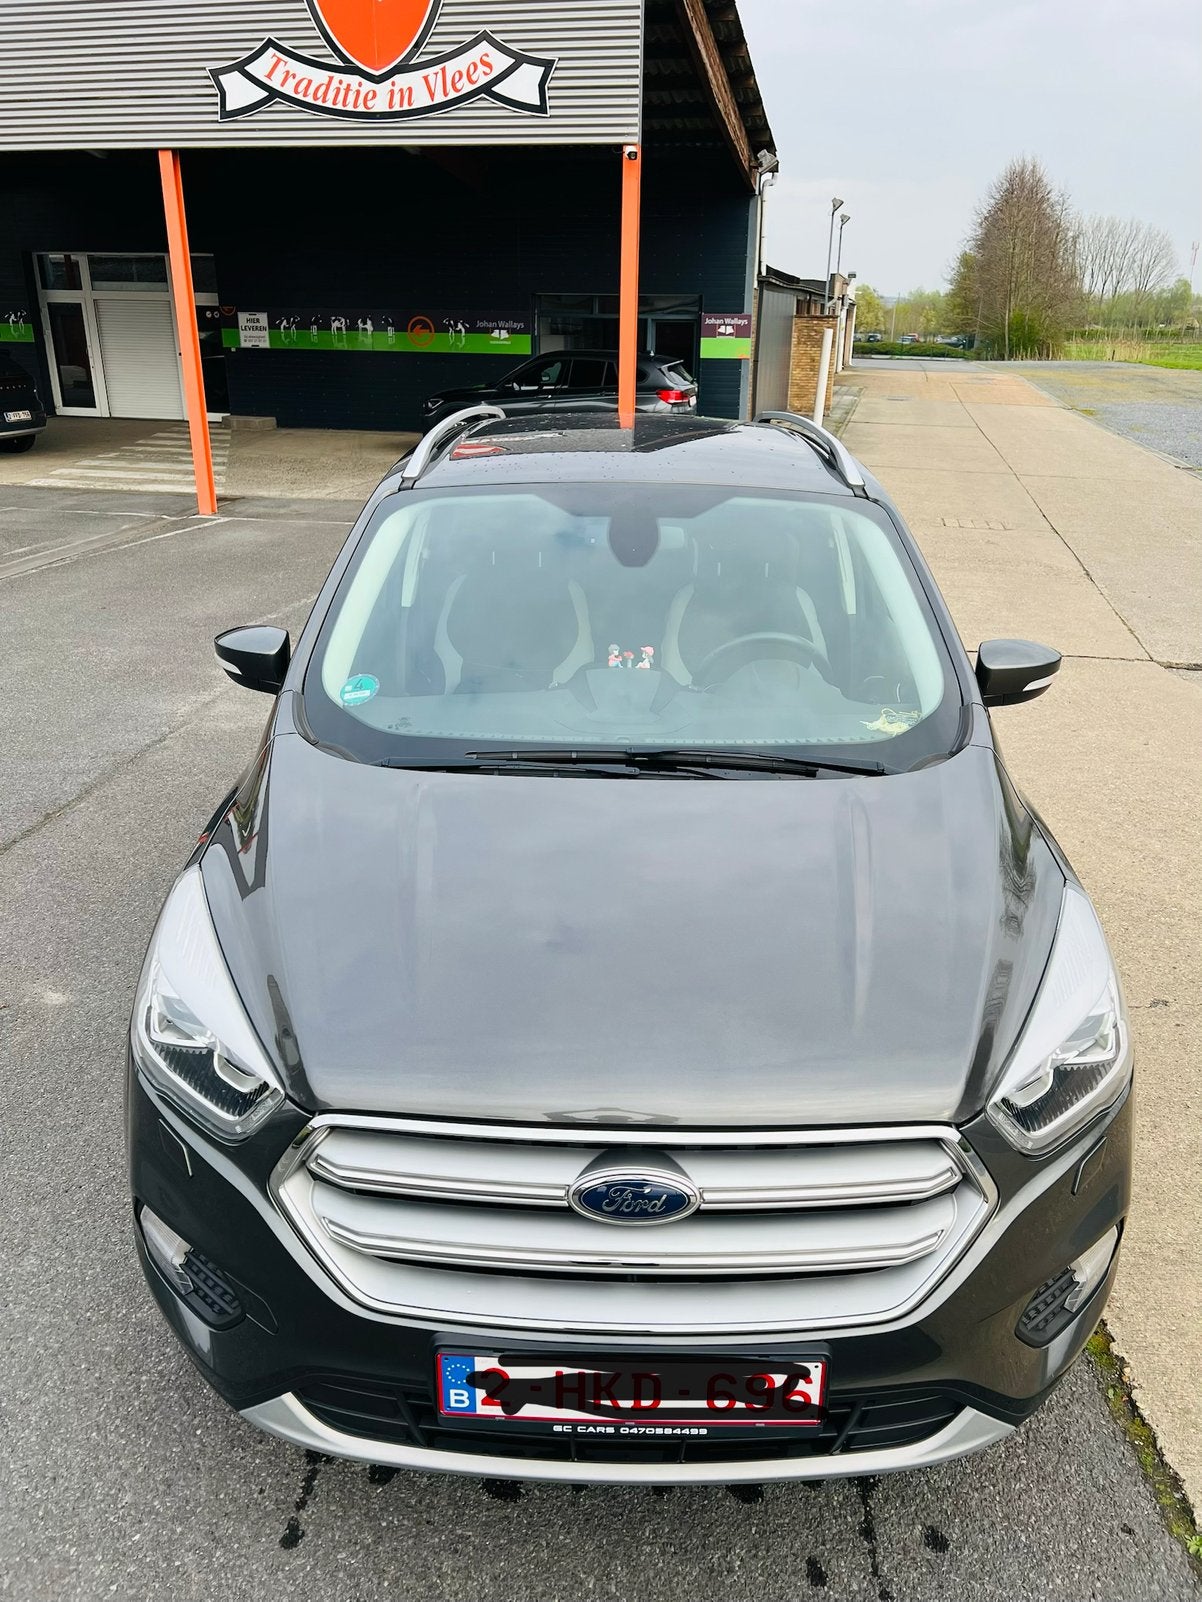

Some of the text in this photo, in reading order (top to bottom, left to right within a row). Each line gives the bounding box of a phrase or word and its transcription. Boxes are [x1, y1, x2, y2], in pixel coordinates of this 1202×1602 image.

[263, 52, 494, 110] Traditie in Vlees
[476, 320, 524, 330] Johan Wallays
[704, 317, 748, 326] Johan Wallays
[353, 678, 364, 690] 4
[602, 1186, 666, 1212] Ford
[450, 1389, 470, 1408] B
[553, 1425, 573, 1433] GC
[577, 1426, 615, 1434] CARS
